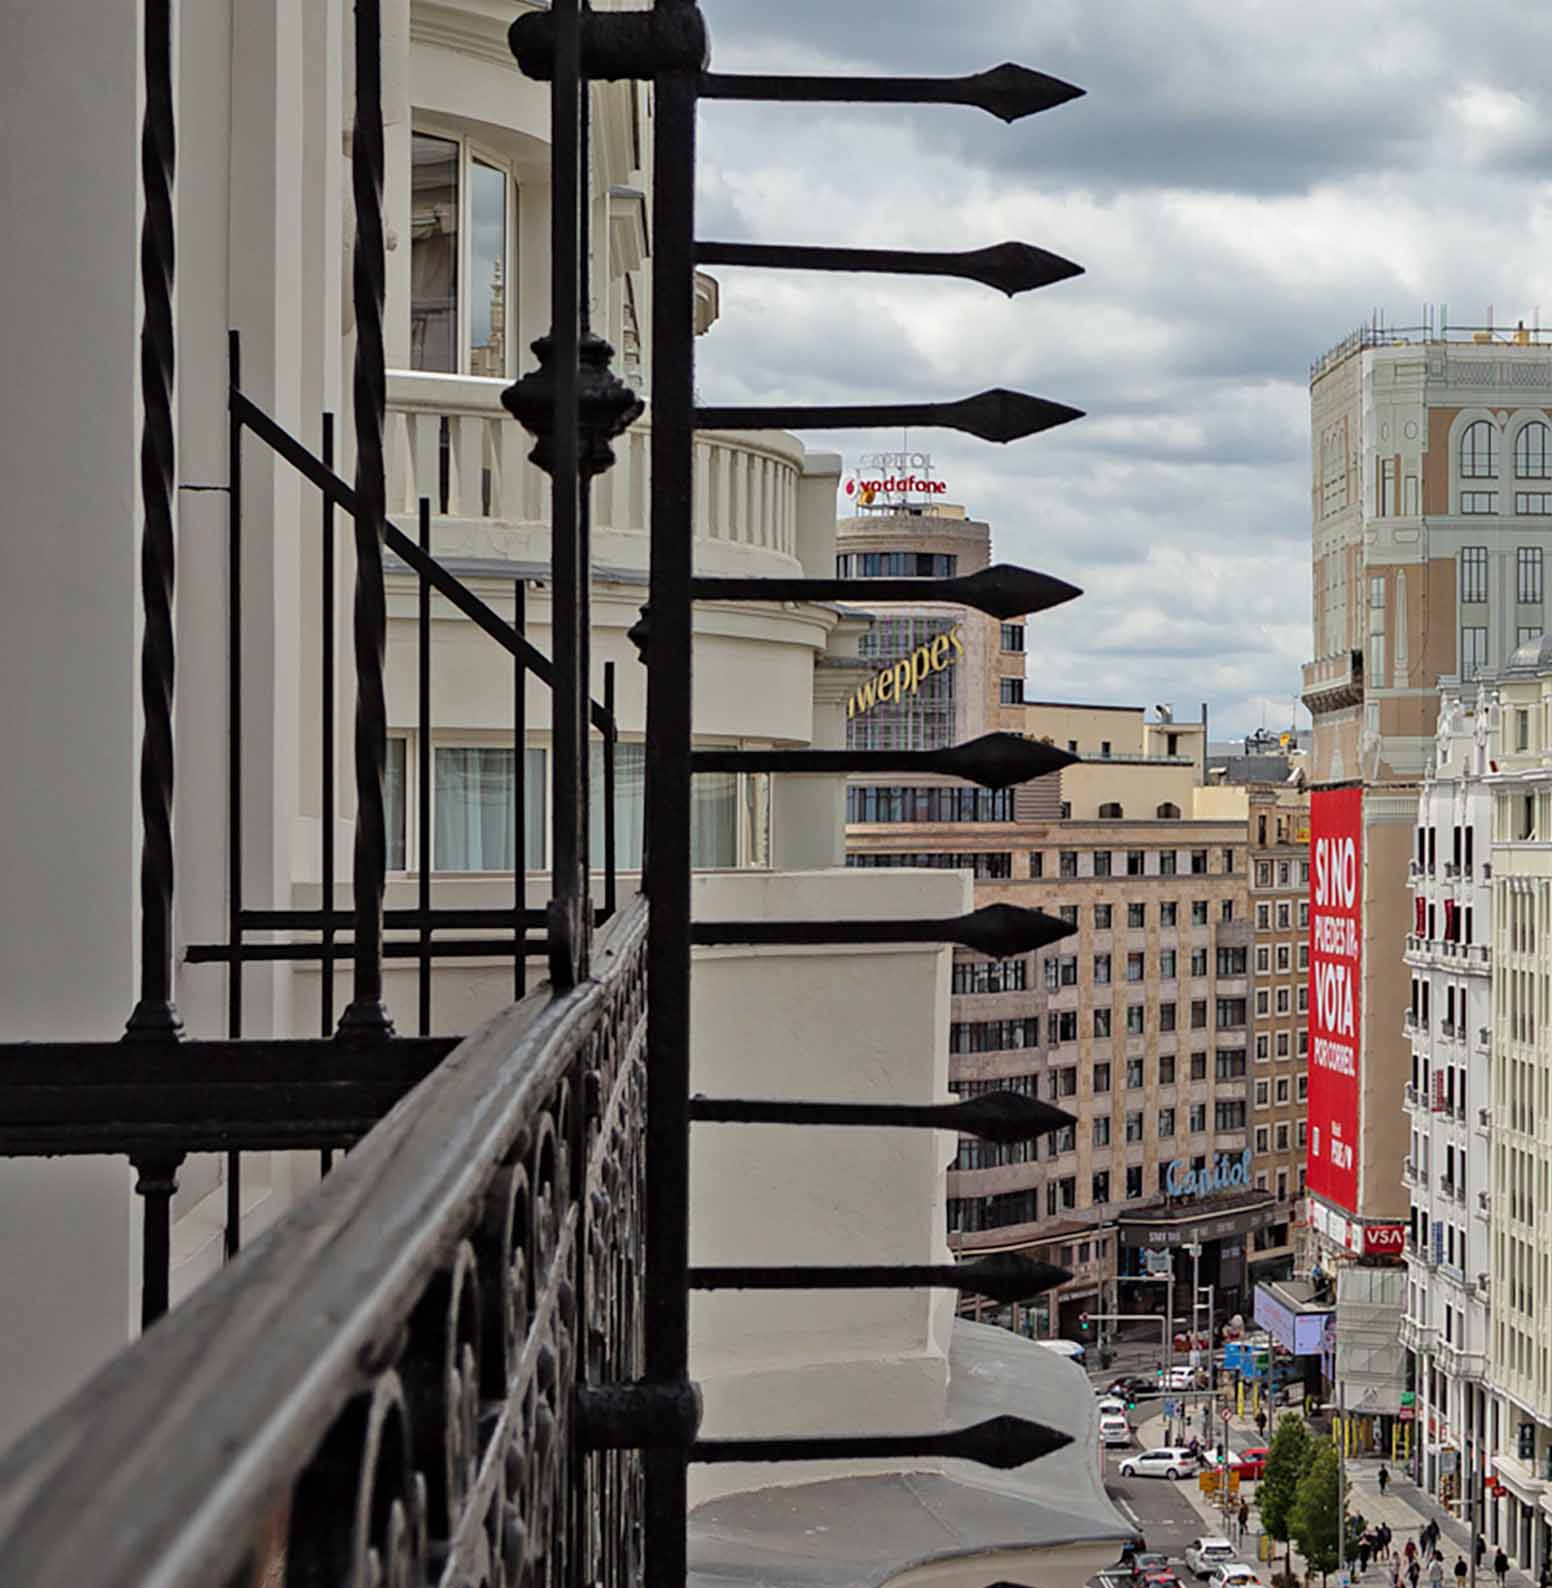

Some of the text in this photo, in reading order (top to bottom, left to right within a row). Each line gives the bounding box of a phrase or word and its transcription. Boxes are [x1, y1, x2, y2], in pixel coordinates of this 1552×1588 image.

[860, 475, 947, 494] vodafone
[1331, 837, 1355, 909] NO
[1315, 960, 1355, 1038] VOTA
[1167, 1147, 1252, 1199] Capitol
